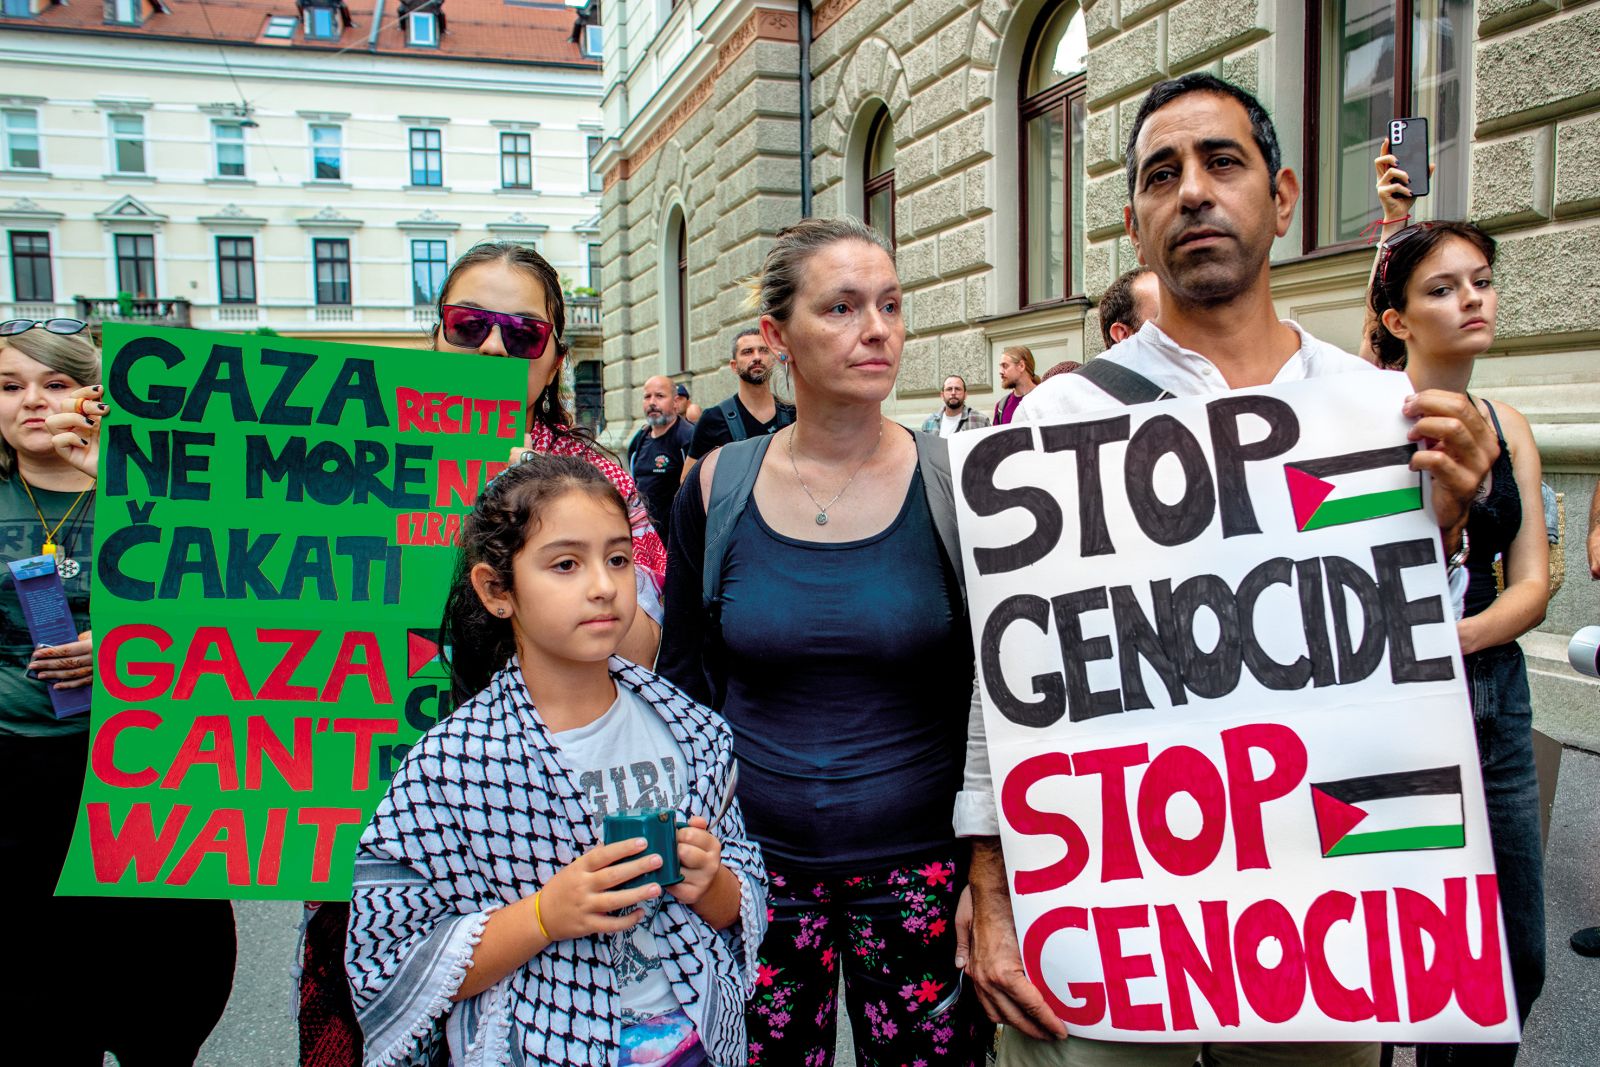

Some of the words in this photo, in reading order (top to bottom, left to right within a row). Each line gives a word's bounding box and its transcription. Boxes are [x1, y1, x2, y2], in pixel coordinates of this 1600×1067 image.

[108, 337, 389, 427] GAZA
[105, 424, 215, 500] NE
[245, 435, 433, 509] MORE
[961, 395, 1300, 575] STOP
[99, 500, 402, 604] ČAKATI
[98, 624, 394, 704] GAZA
[980, 538, 1455, 728] GENOCIDE
[91, 709, 399, 791] CAN'T
[579, 756, 686, 829] GIRL
[86, 802, 362, 885] WAIT
[1001, 723, 1307, 894] STOP
[1023, 874, 1508, 1031] GENOCIDU
